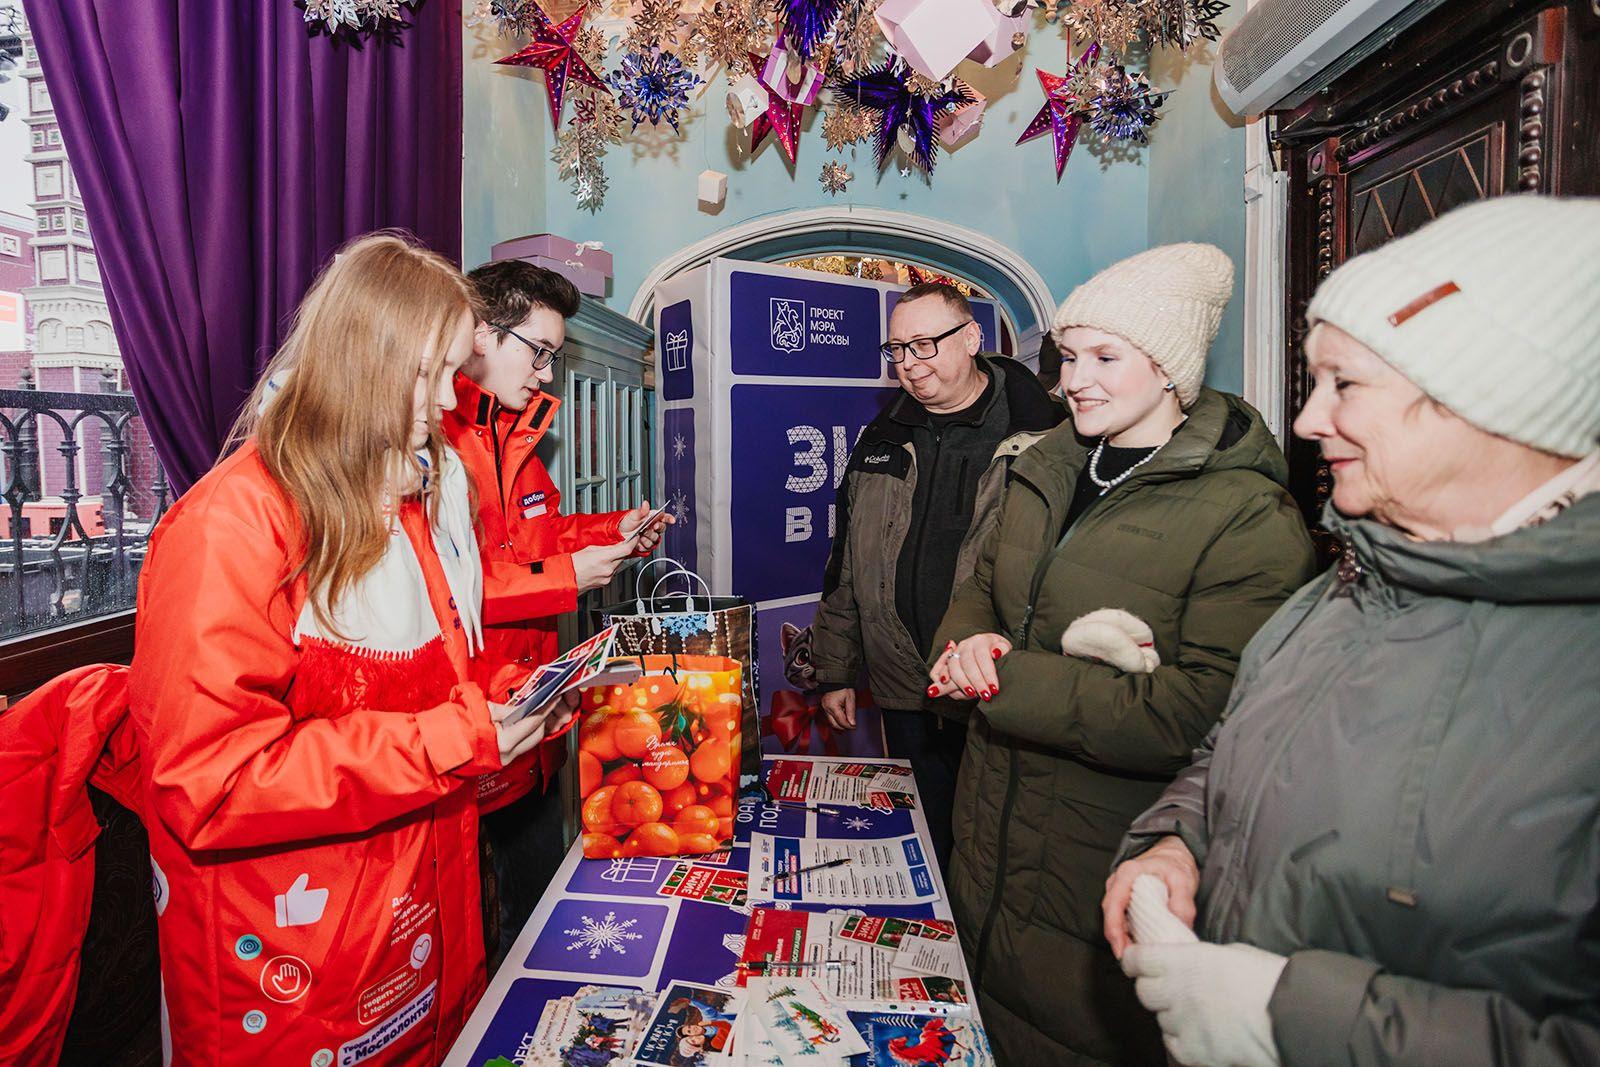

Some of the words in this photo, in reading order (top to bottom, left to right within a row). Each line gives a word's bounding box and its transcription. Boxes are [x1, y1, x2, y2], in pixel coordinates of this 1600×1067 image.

[810, 307, 845, 320] ПРОЕКТ
[810, 320, 836, 332] МЭРА
[810, 333, 850, 346] МОСКВЫ
[785, 425, 866, 494] ЗИ
[785, 506, 813, 543] В
[737, 802, 756, 823] ФА
[681, 870, 705, 894] ЗИМА
[858, 917, 875, 938] ЗИМА
[416, 987, 435, 1006] вмест
[343, 1056, 352, 1066] с
